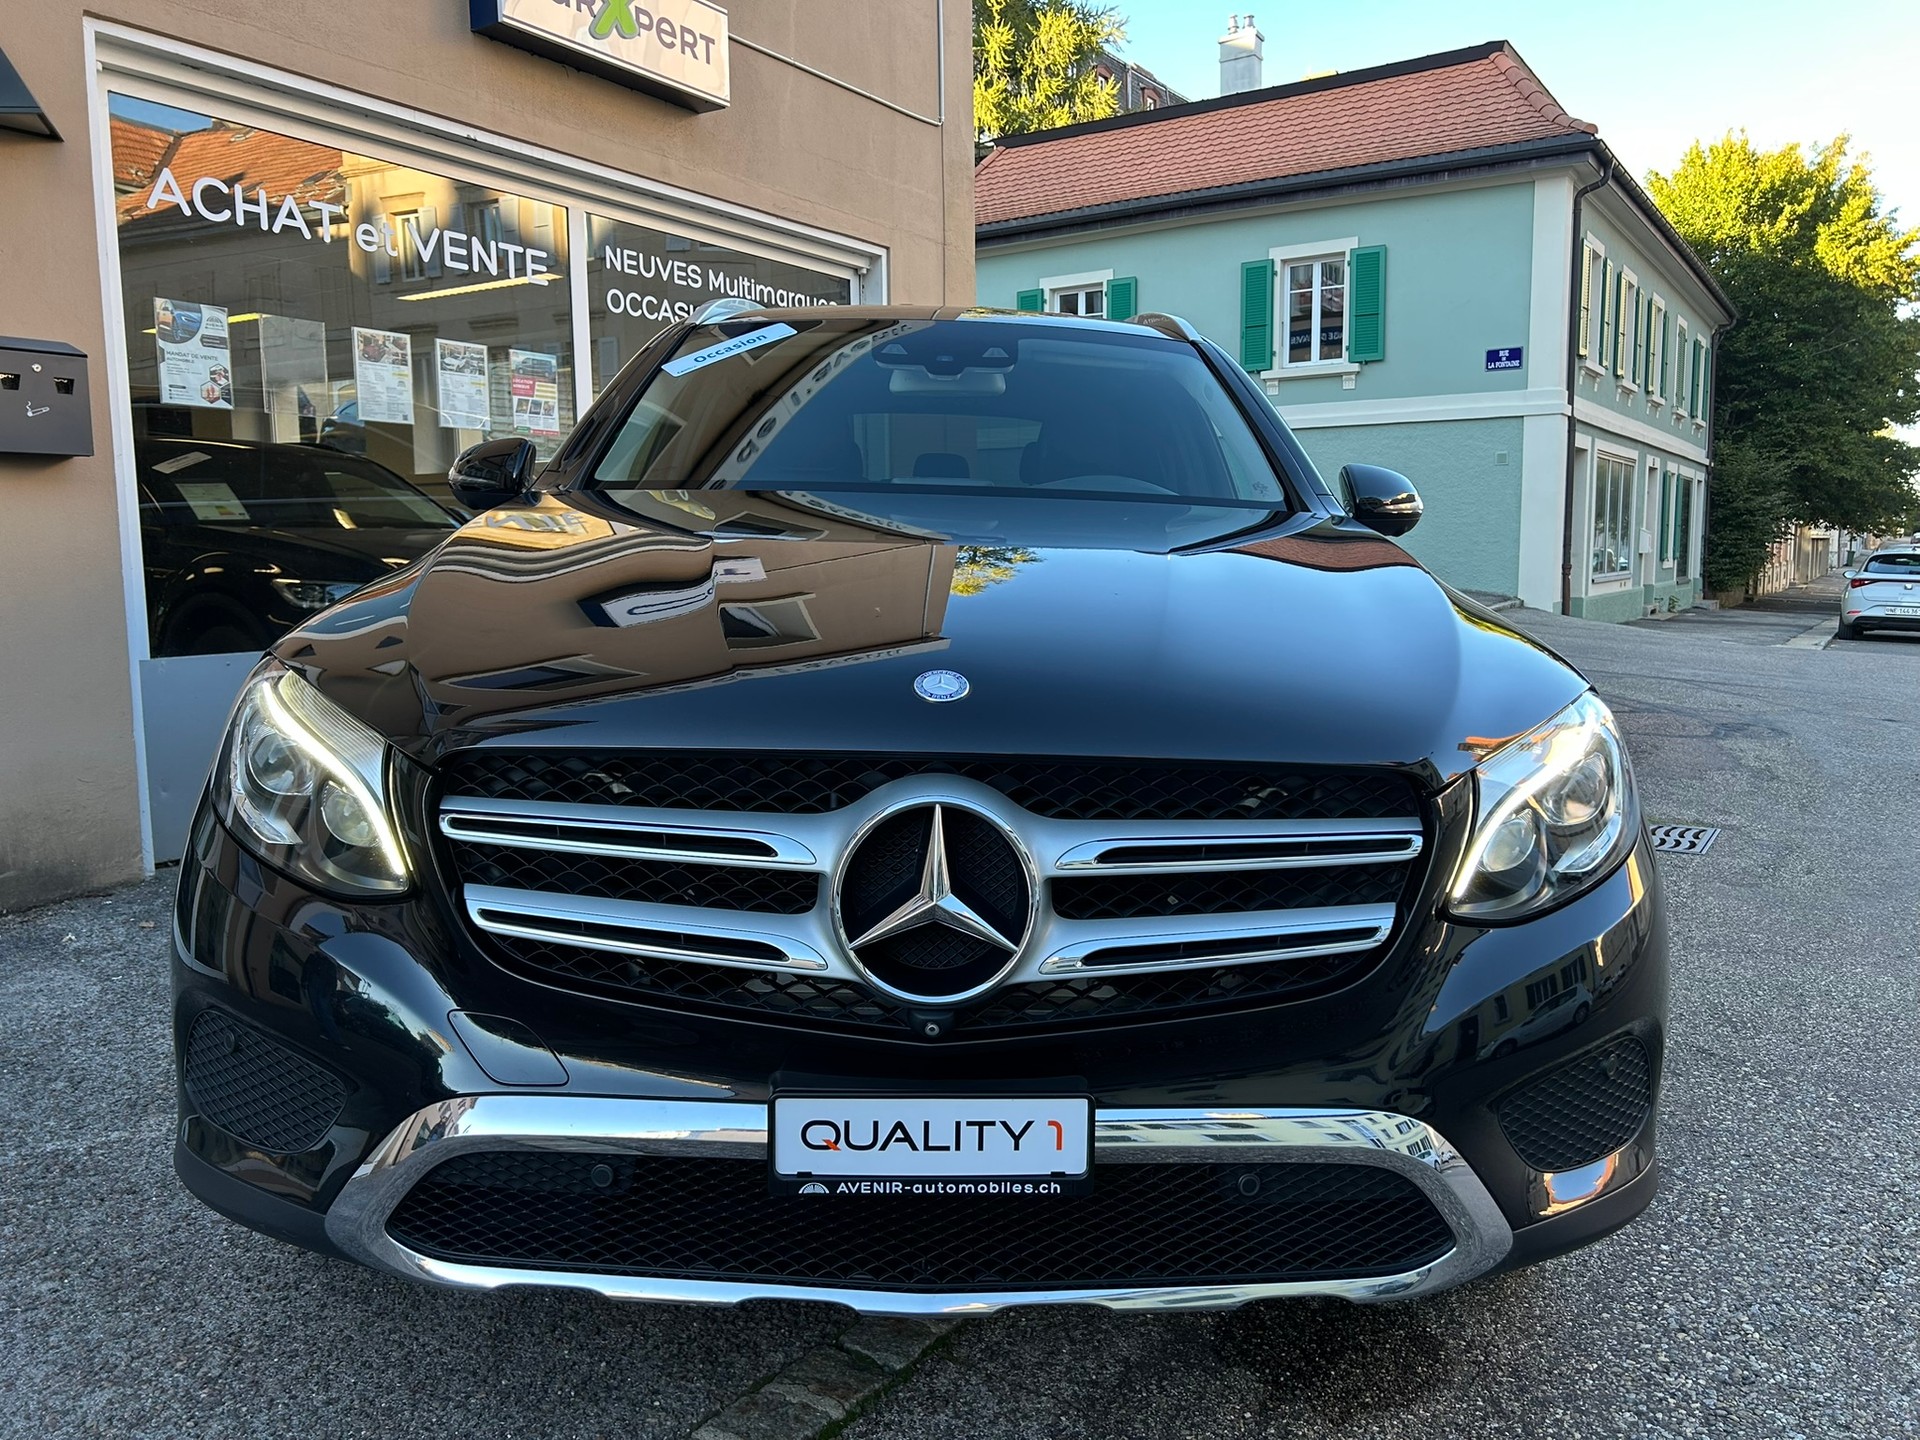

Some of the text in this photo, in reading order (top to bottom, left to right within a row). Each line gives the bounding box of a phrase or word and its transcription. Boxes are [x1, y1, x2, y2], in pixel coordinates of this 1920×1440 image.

[146, 168, 550, 286] ACHAT et VENTE
[605, 245, 702, 288] NEUVES
[606, 288, 695, 323] OCCASI
[166, 350, 190, 358] MANDAT
[693, 333, 768, 363] Occasion
[1495, 360, 1520, 368] FONTAINE
[800, 1119, 1063, 1151] QUALITY 1
[836, 1181, 1061, 1194] AVENIR-automobiles.ch
